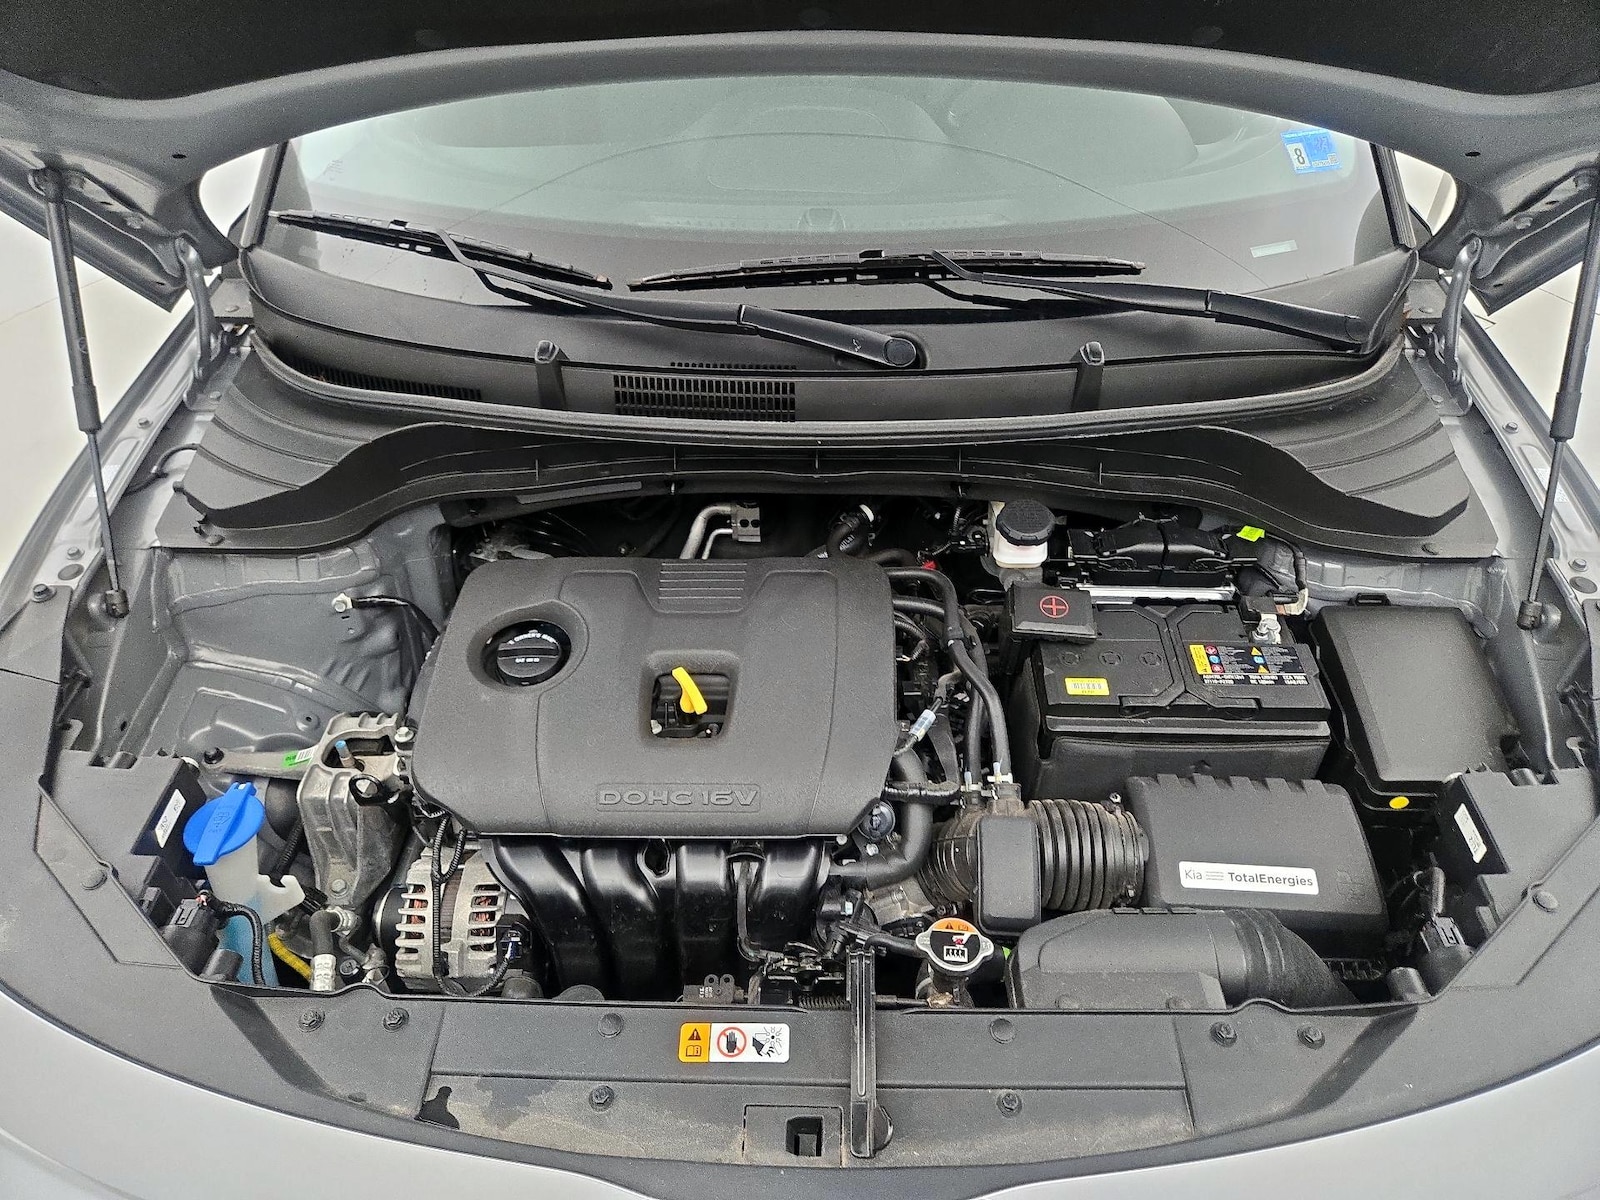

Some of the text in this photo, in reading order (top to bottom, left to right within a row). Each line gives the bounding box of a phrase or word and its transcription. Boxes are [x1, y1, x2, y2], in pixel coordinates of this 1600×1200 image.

[1294, 148, 1306, 164] 8
[597, 789, 759, 807] DOHC 16V
[1184, 869, 1314, 887] Kia TotalEnergies
